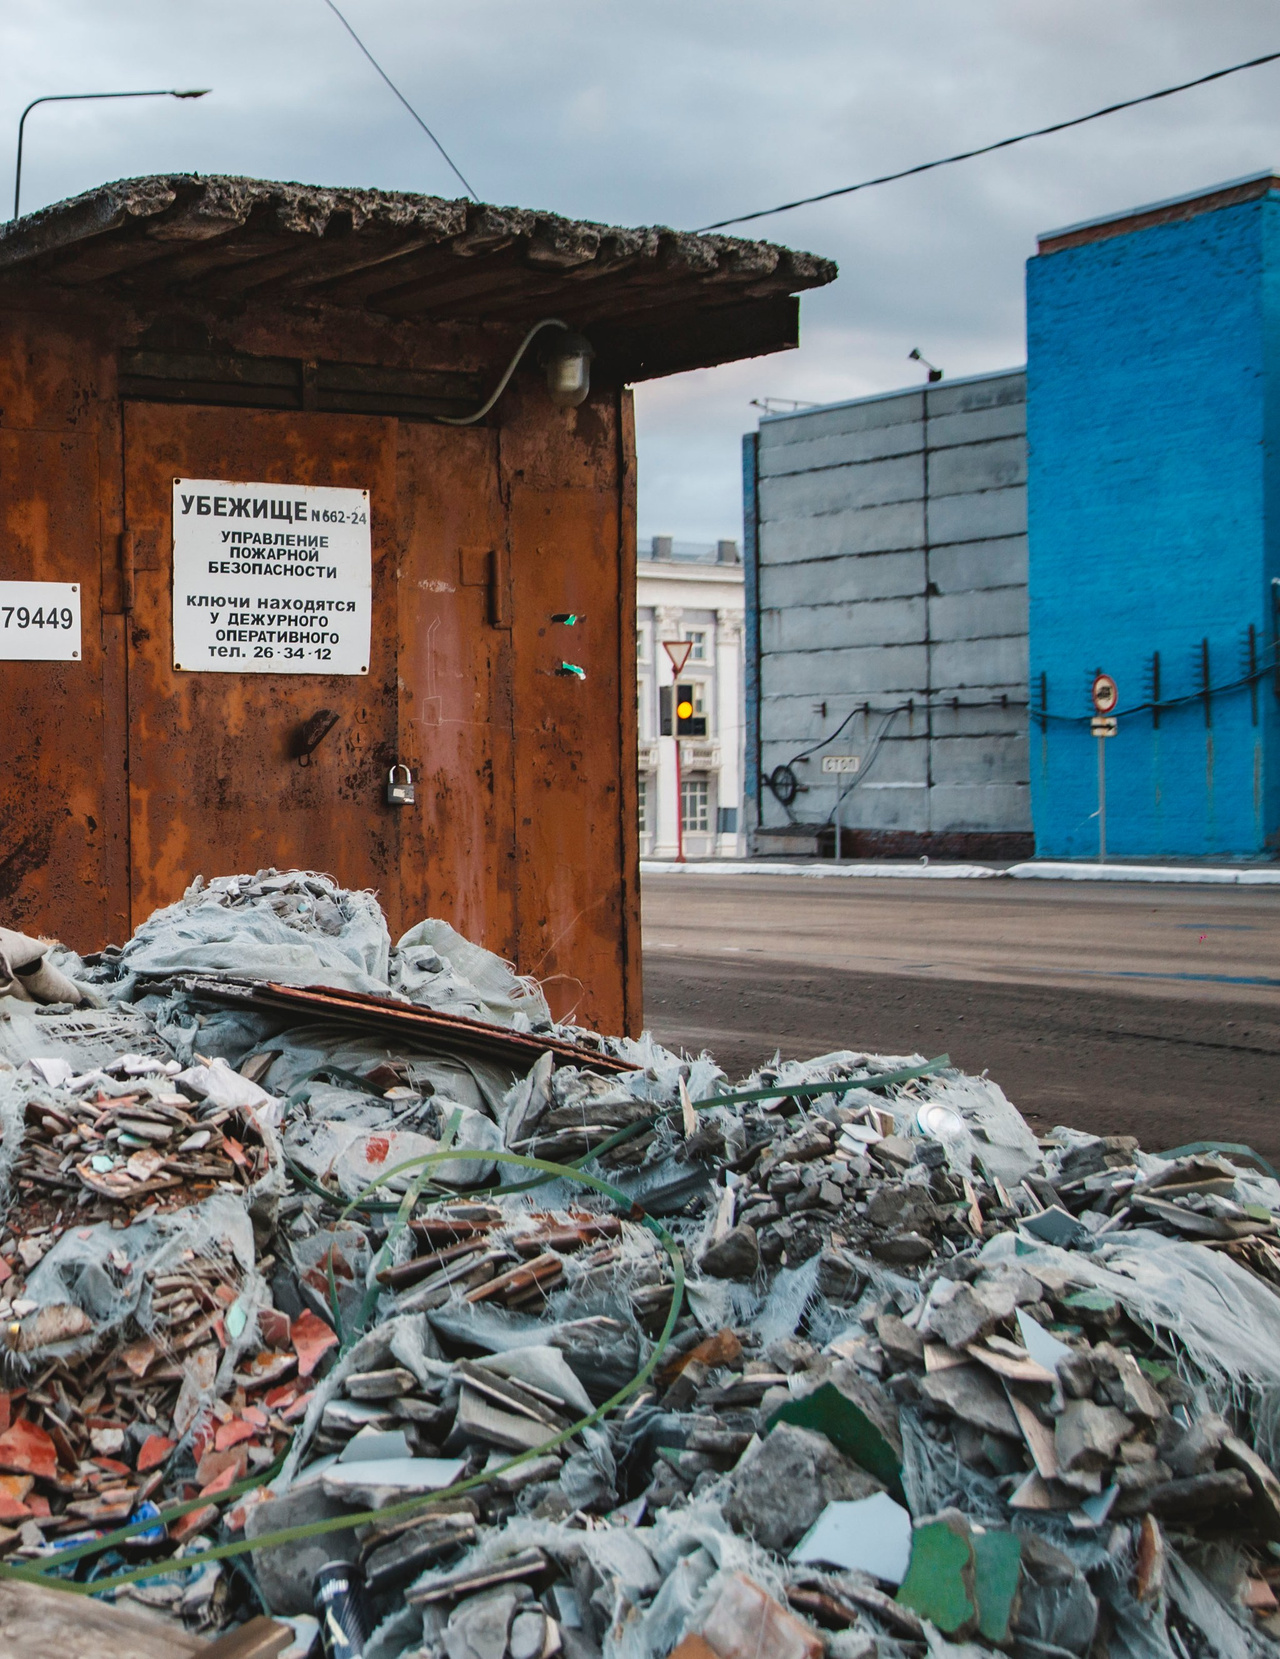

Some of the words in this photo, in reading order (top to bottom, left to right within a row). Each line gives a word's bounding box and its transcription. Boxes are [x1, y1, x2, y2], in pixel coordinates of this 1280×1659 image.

[181, 494, 308, 524] УБЕЖИЩЕ
[221, 530, 329, 548] УПРАВЛЕНИЕ
[229, 547, 319, 562] ПОЖАРНОЙ
[208, 561, 337, 578] БЕЗОПАСНОСТИ
[257, 597, 356, 613] находятся
[210, 612, 219, 625] У
[227, 612, 329, 627] ДЕЖУРНОГО
[215, 629, 340, 644] ОПЕРАТИВНОГО
[208, 645, 247, 658] тел.
